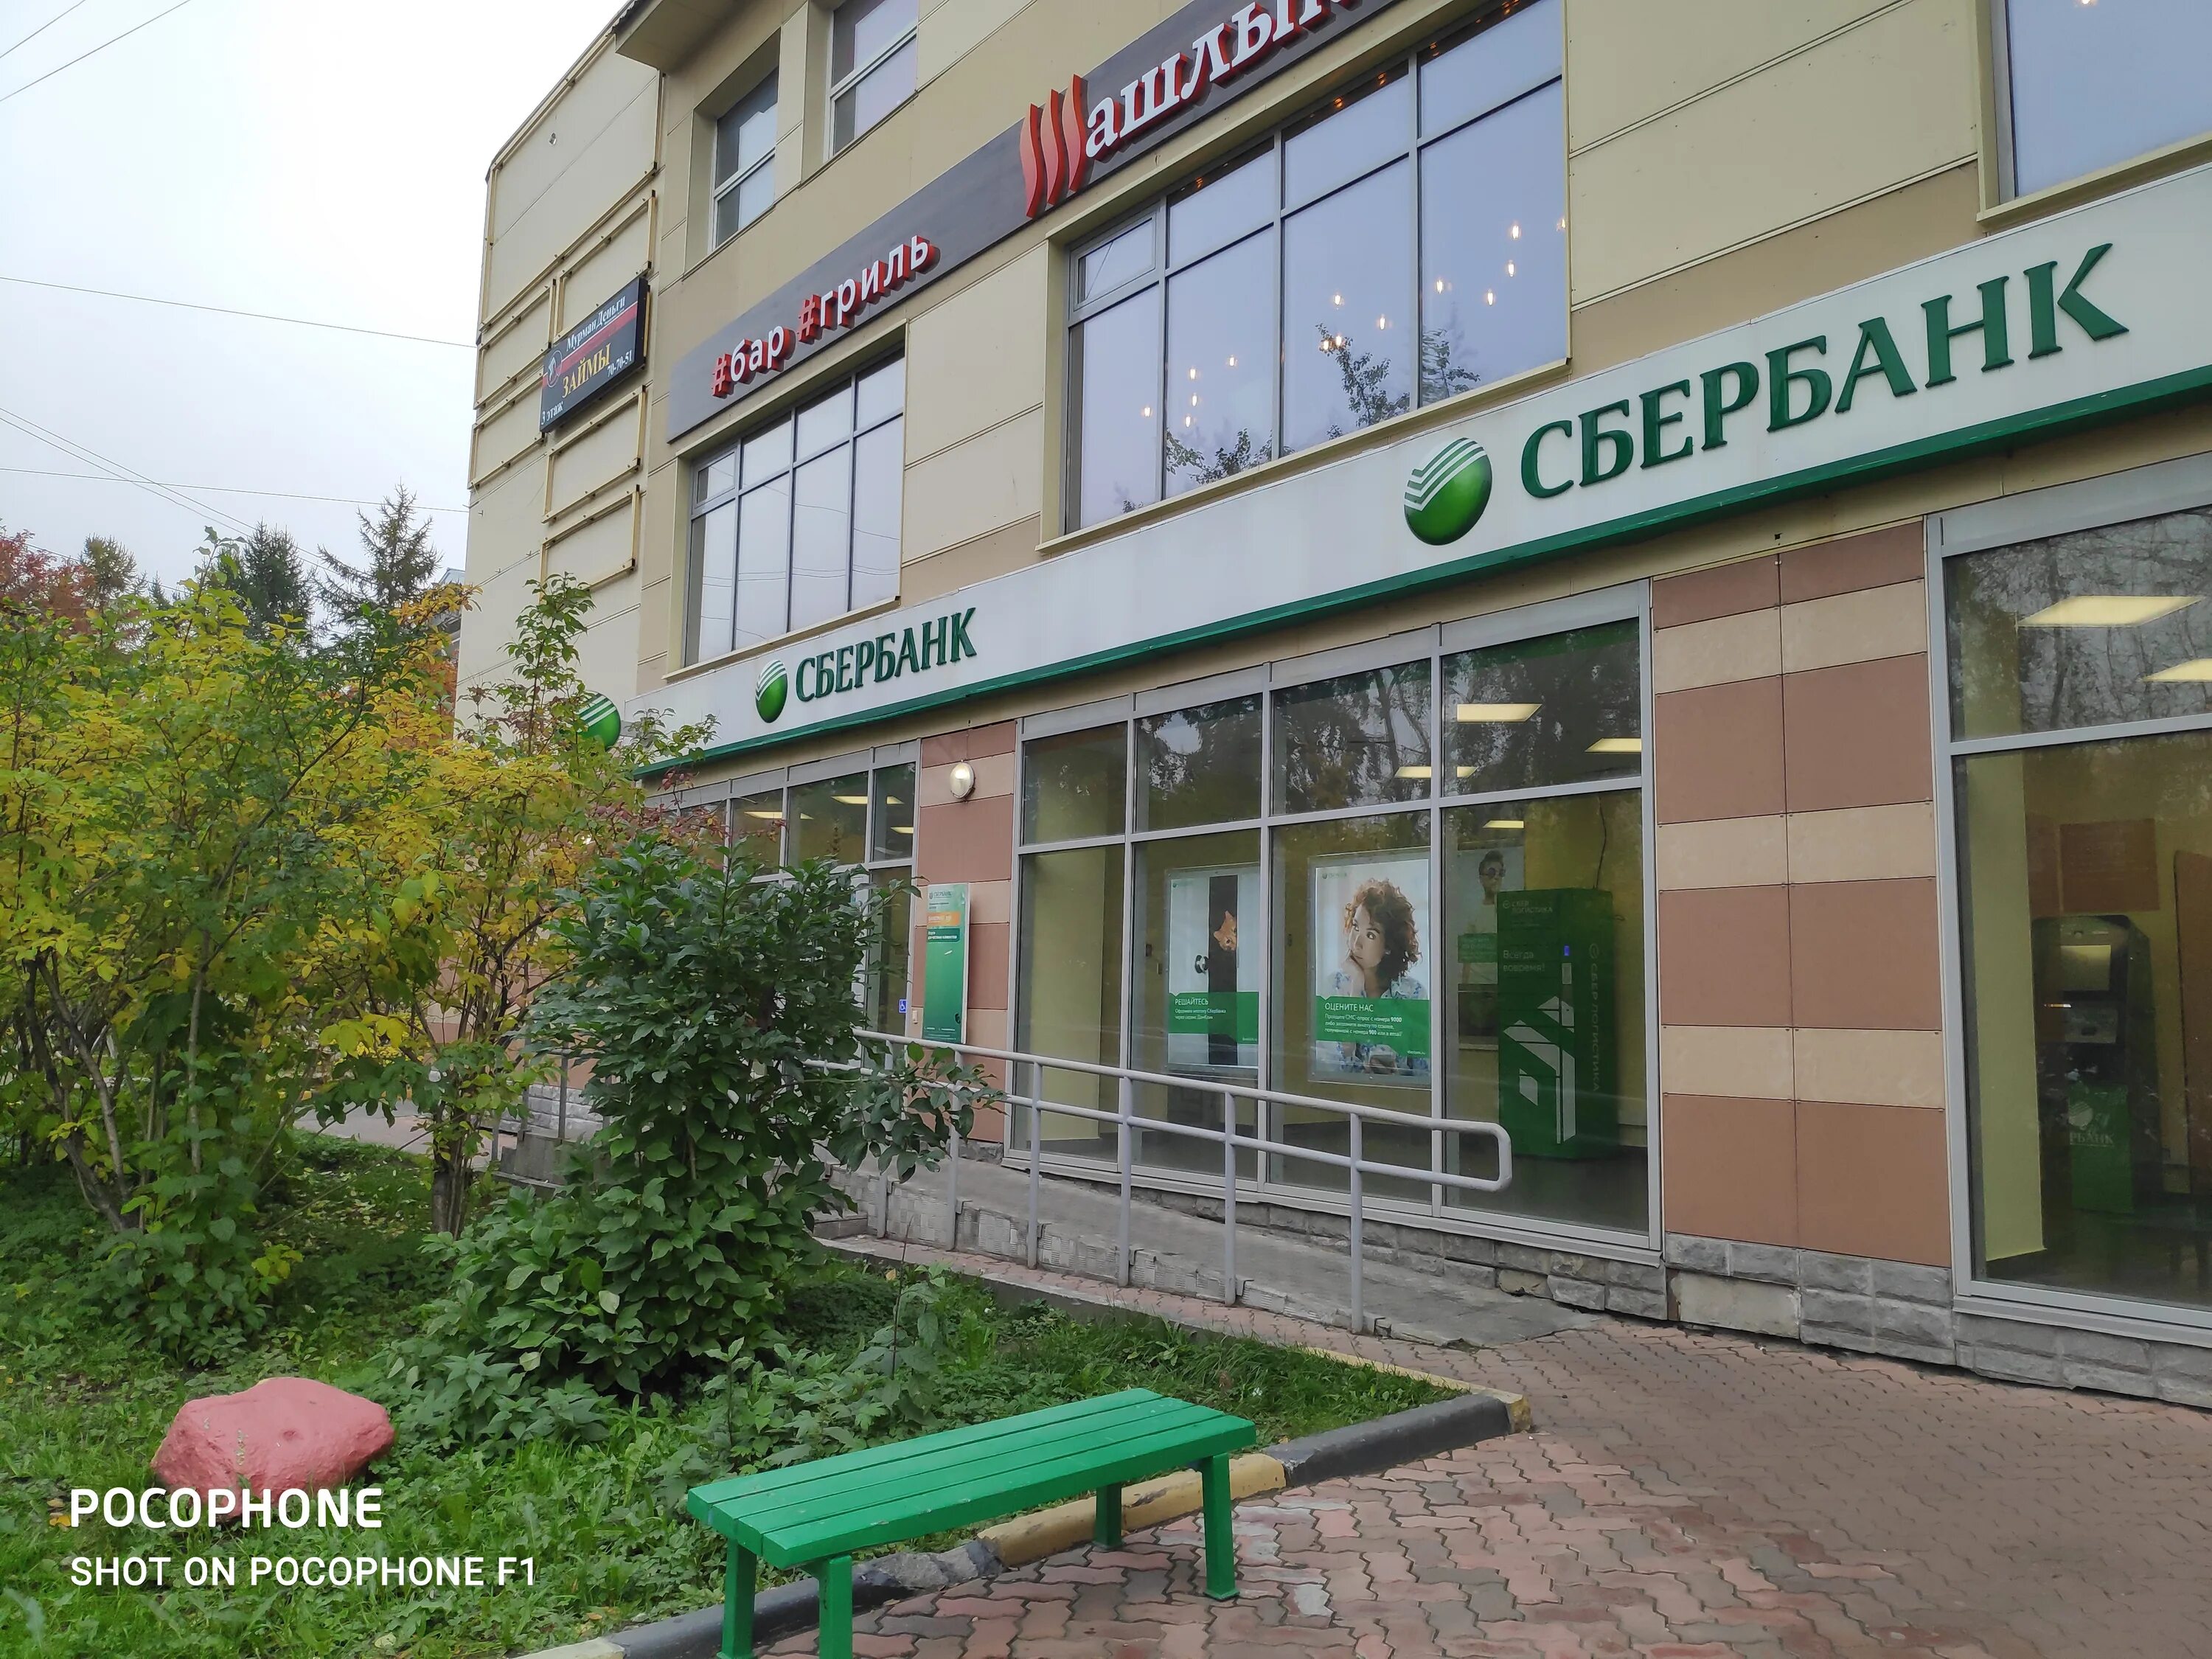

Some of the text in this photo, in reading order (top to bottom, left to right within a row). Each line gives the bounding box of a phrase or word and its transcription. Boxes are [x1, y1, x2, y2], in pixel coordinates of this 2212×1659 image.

[712, 234, 931, 398] #бар #гриль
[562, 343, 611, 398] ЗАЙМЫ
[607, 349, 633, 378] 70-70-51
[1520, 243, 2130, 500] СБЕРБАНК
[540, 400, 564, 425] 3 этаж
[796, 607, 978, 703] СБЕРБАНК
[1175, 997, 1209, 1006] РЕШАЙТЕСЬ
[1324, 1002, 1374, 1012] ОЦЕНИТЕ НАС
